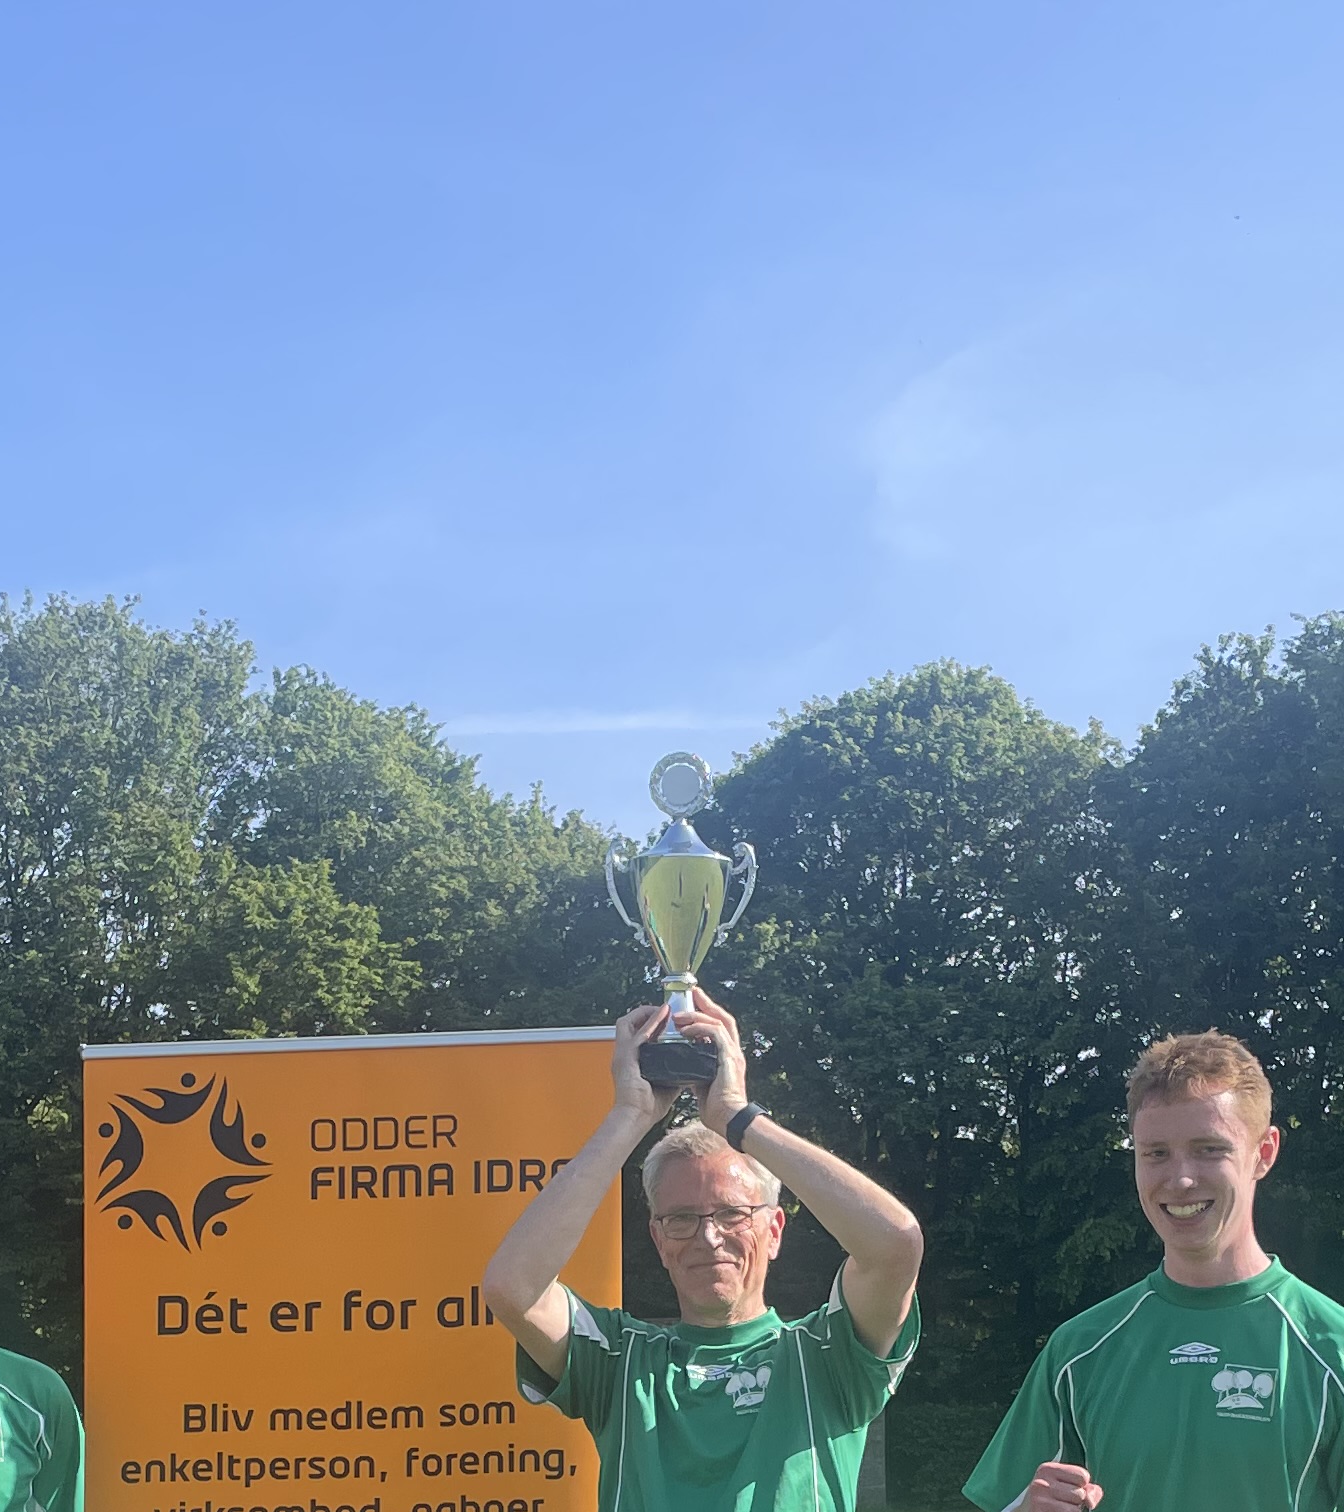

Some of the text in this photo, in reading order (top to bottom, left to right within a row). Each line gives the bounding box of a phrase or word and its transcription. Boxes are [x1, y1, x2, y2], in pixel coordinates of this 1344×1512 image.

[310, 1114, 458, 1152] ODDER
[310, 1158, 574, 1200] FIRMA IDR
[157, 1285, 494, 1336] Dét er for al
[183, 1400, 516, 1434] Bliv medlem som
[120, 1443, 577, 1488] enkeltperson, forening,
